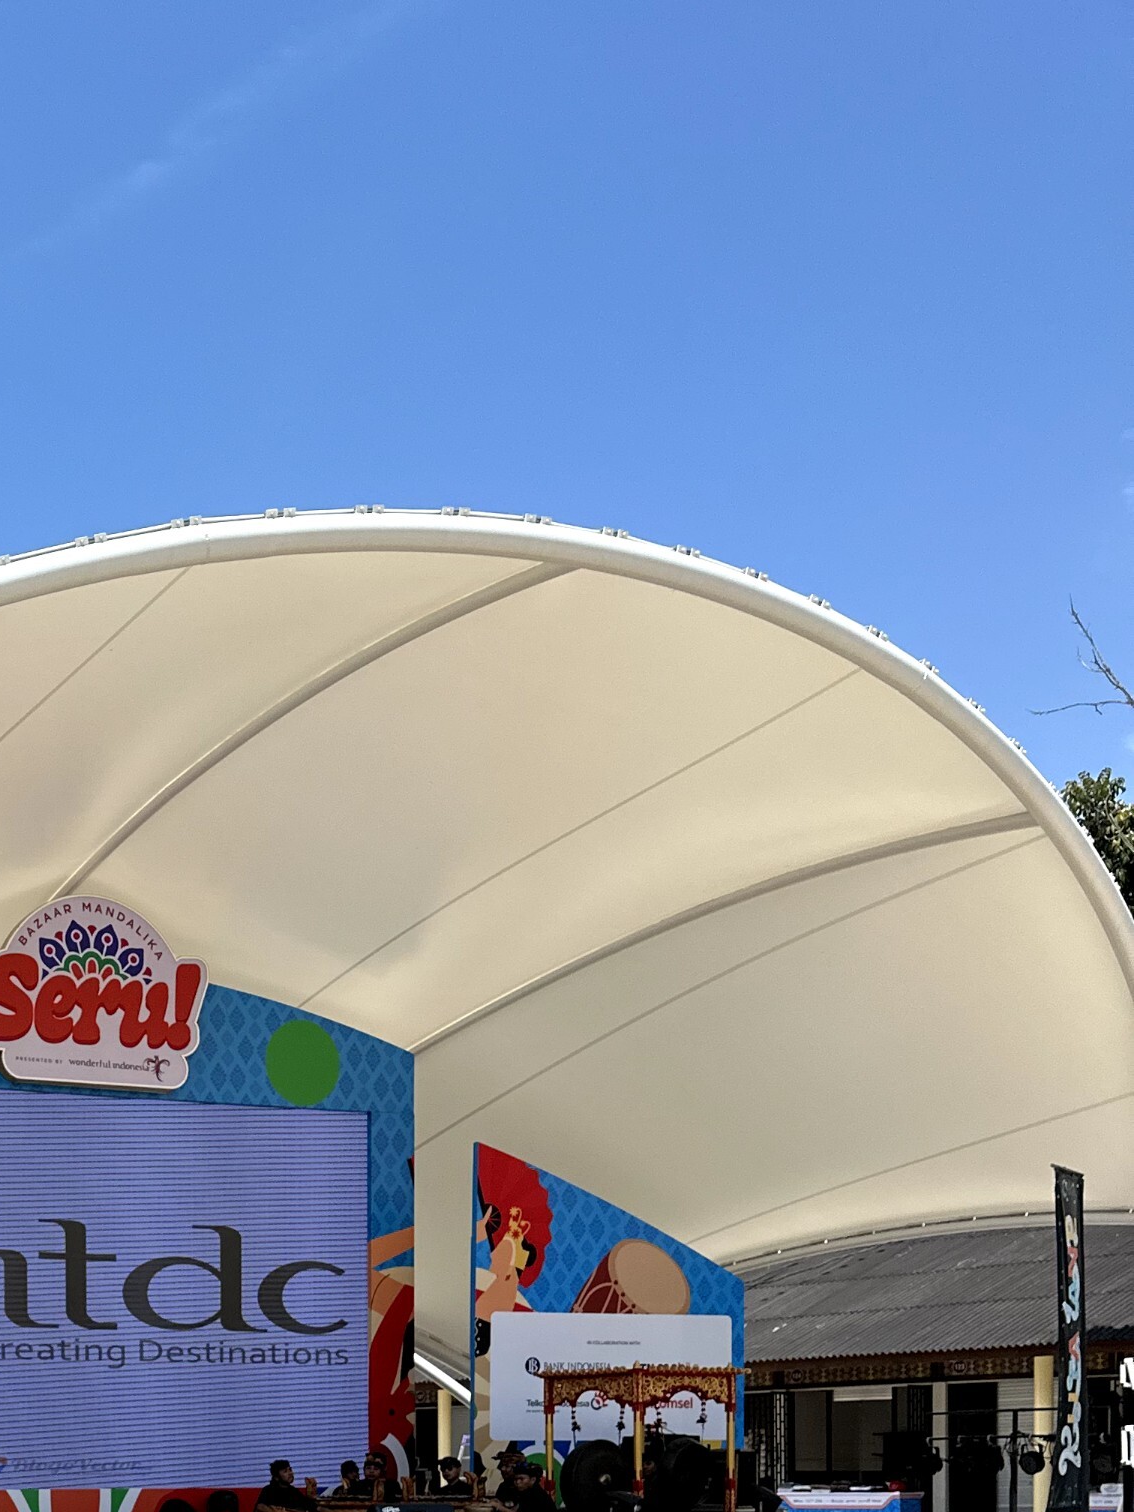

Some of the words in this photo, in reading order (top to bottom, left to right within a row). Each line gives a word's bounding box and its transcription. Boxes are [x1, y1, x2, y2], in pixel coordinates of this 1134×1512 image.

[18, 903, 73, 946] BAZAAR
[82, 902, 163, 961] MANDALIKA
[139, 1340, 350, 1367] Destinations
[543, 1361, 565, 1371] BANK
